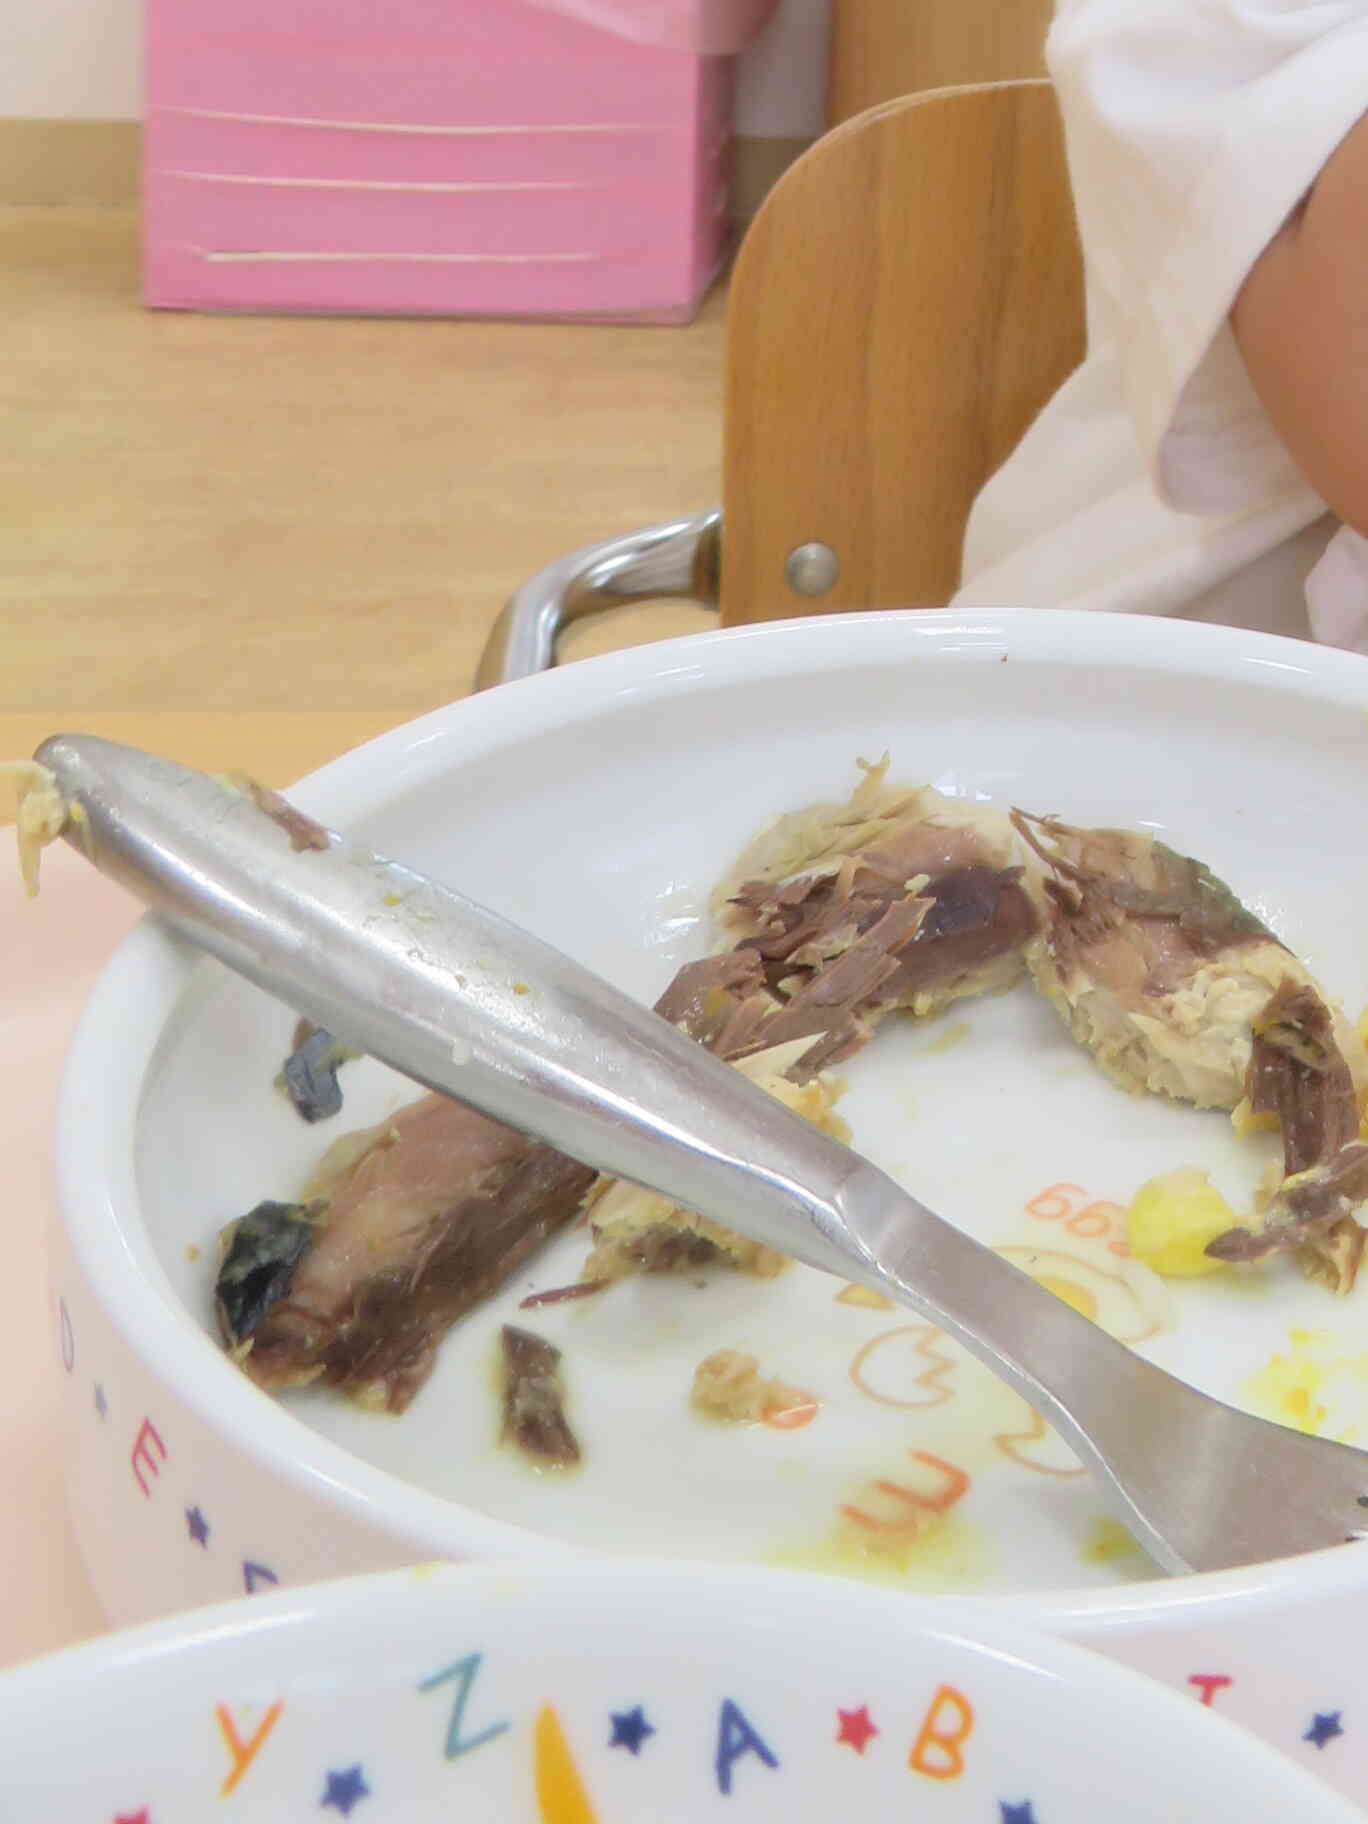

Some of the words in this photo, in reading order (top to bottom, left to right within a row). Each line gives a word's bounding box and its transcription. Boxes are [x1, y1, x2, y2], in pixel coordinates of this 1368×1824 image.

[131, 1416, 168, 1500] E
[214, 1699, 285, 1800] Y
[417, 1651, 511, 1762] Z
[715, 1696, 780, 1797] A
[908, 1683, 976, 1780] B
